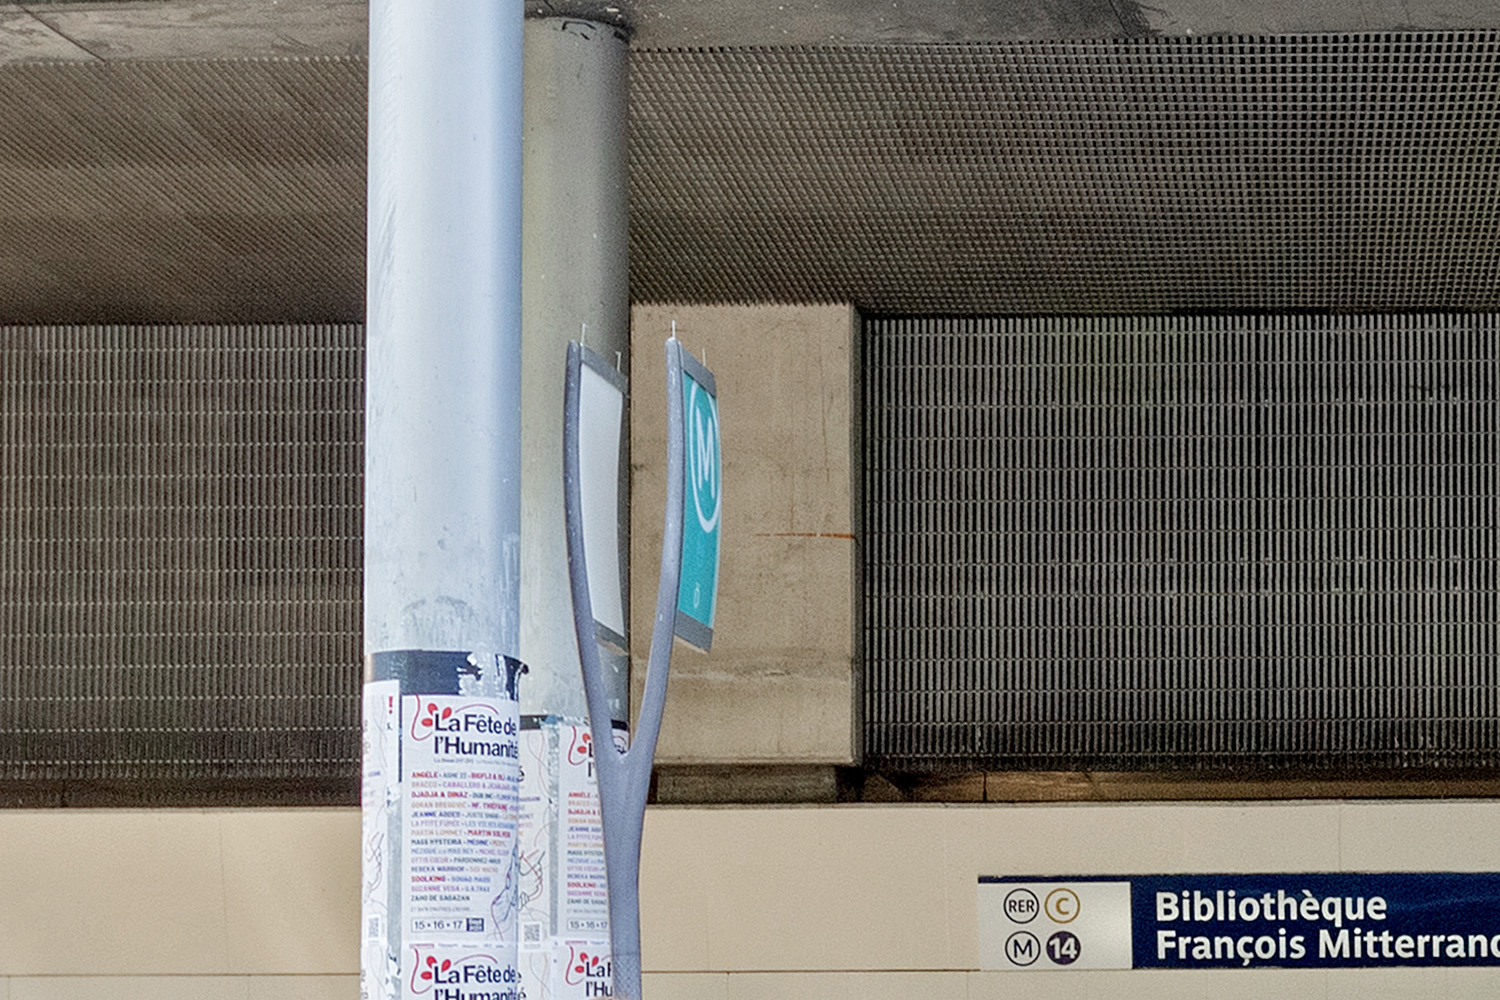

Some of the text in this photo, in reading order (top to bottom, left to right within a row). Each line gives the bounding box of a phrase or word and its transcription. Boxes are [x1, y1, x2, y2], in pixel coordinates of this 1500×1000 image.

[696, 406, 715, 499] M
[435, 713, 516, 736] La Fête de
[1008, 898, 1069, 915] RER C
[1155, 889, 1388, 928] Bibliothèque
[415, 921, 424, 929] 15
[434, 921, 444, 929] 16
[453, 921, 462, 929] 17
[1014, 937, 1078, 959] M 14
[1157, 928, 1307, 966] François
[434, 965, 516, 984] La Fête de
[586, 962, 605, 977] La
